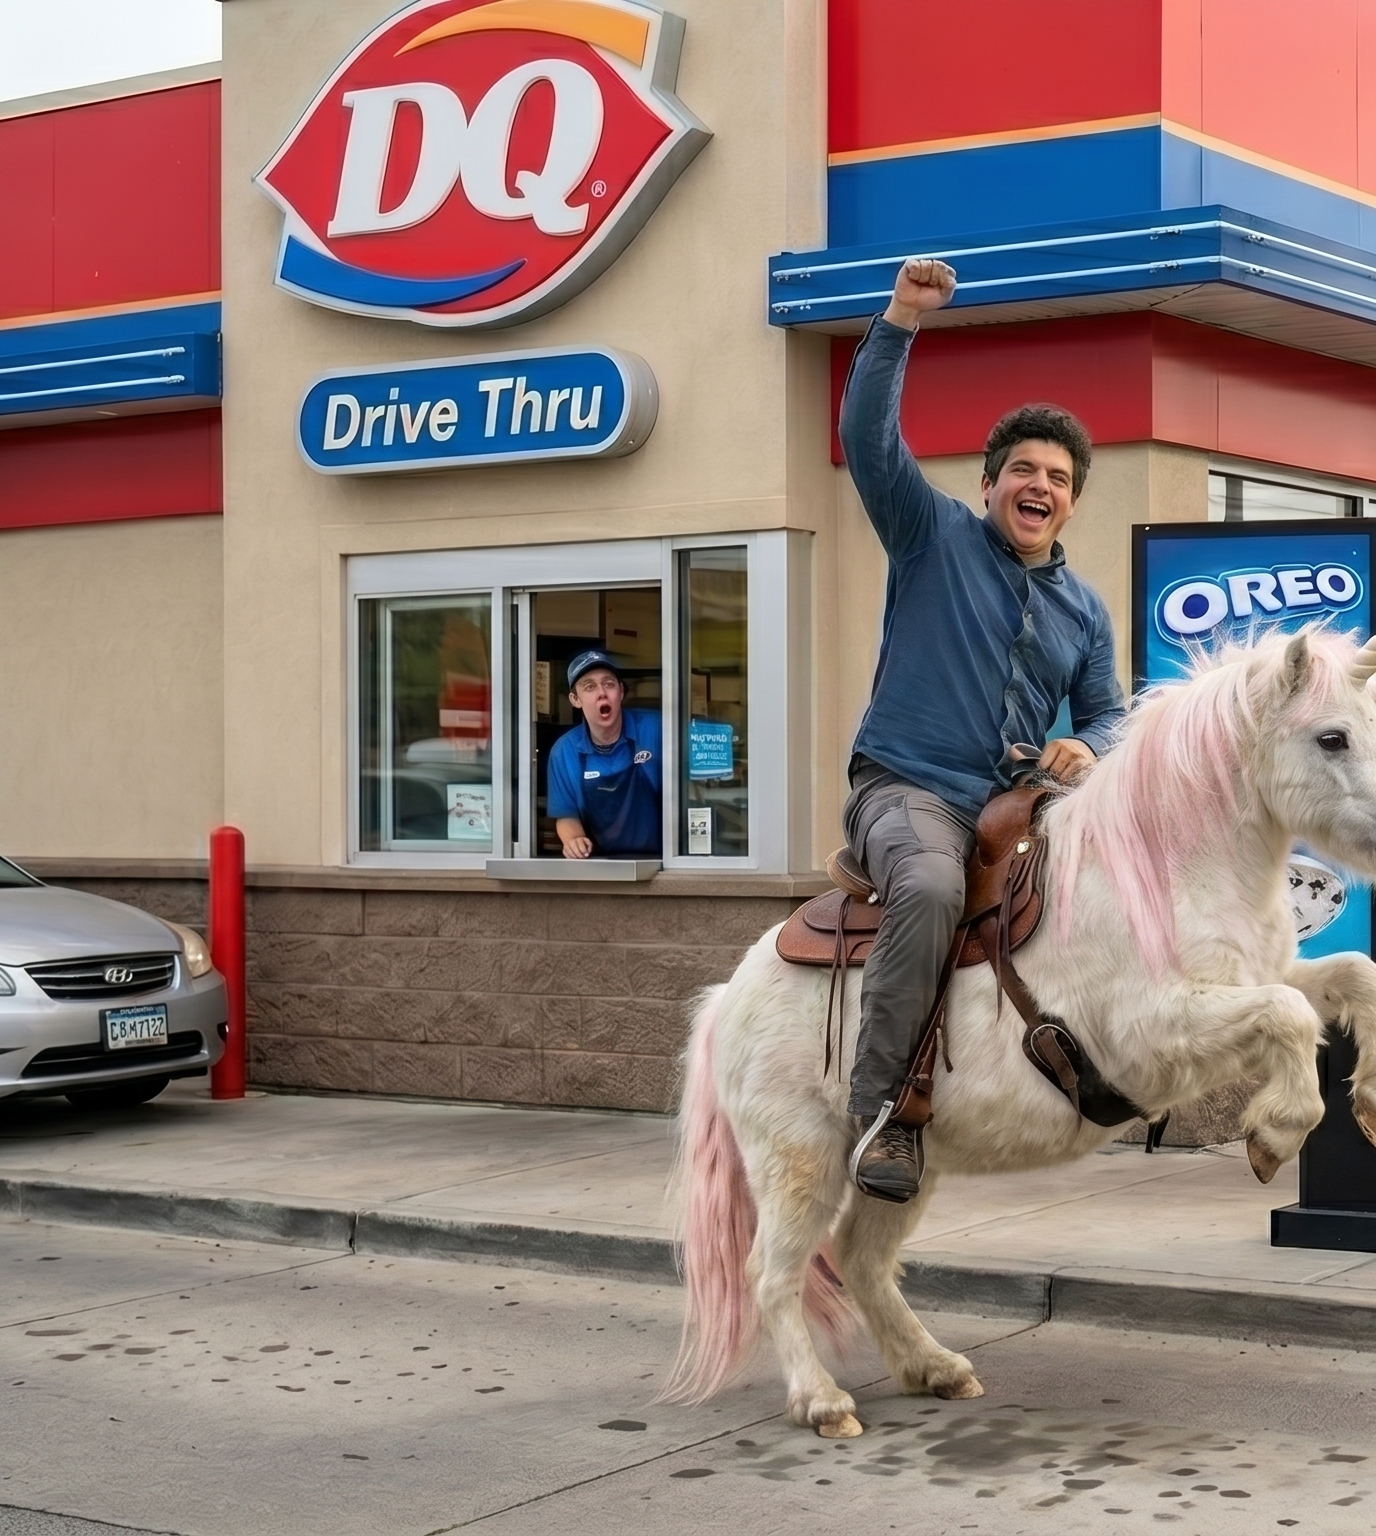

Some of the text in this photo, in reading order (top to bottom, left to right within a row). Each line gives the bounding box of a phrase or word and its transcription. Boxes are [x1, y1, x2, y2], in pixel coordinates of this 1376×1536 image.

[327, 58, 589, 237] DQ
[322, 376, 603, 451] Drive Thru
[1163, 567, 1357, 635] OREO
